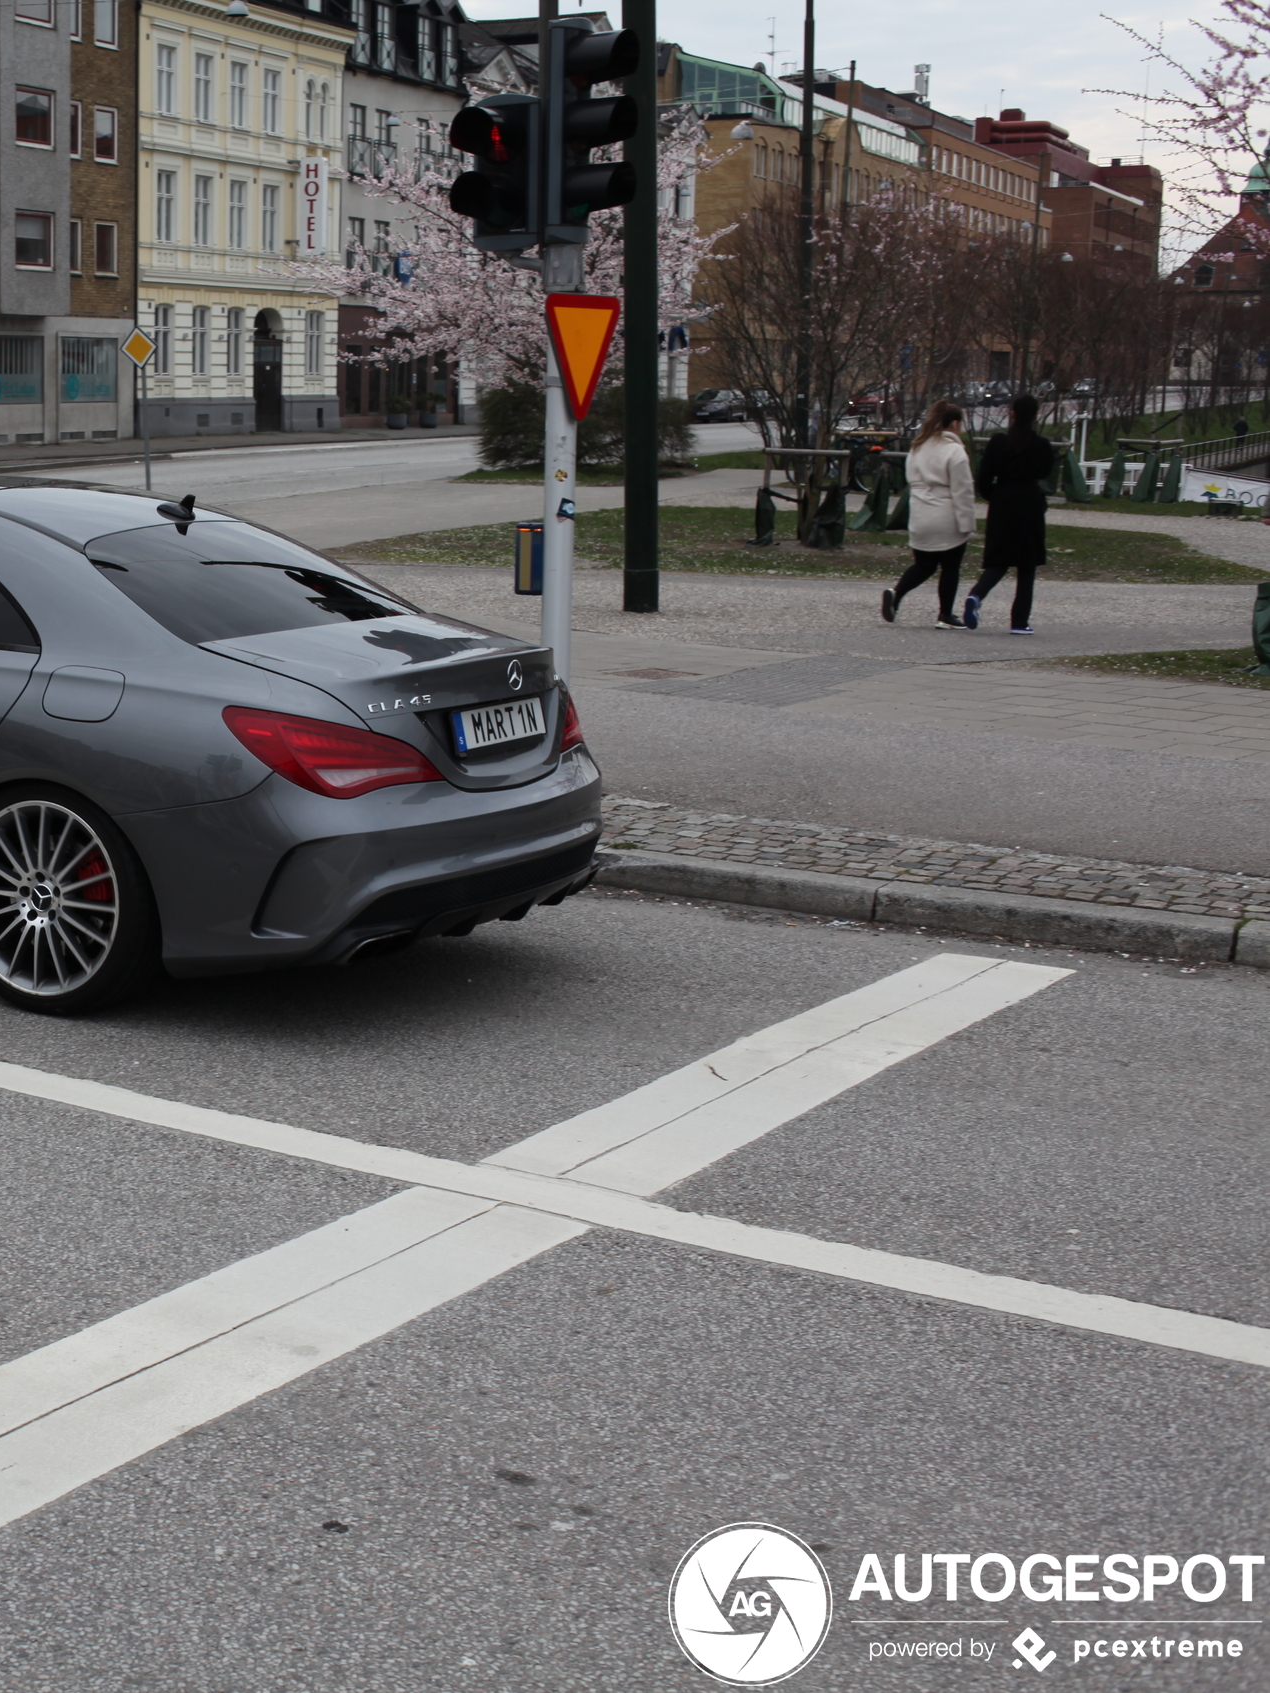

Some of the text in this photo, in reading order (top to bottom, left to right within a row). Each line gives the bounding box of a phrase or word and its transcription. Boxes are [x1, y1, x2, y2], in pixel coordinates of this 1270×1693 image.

[304, 163, 320, 249] HOTEL
[367, 694, 432, 713] CLA 45
[459, 736, 465, 745] S
